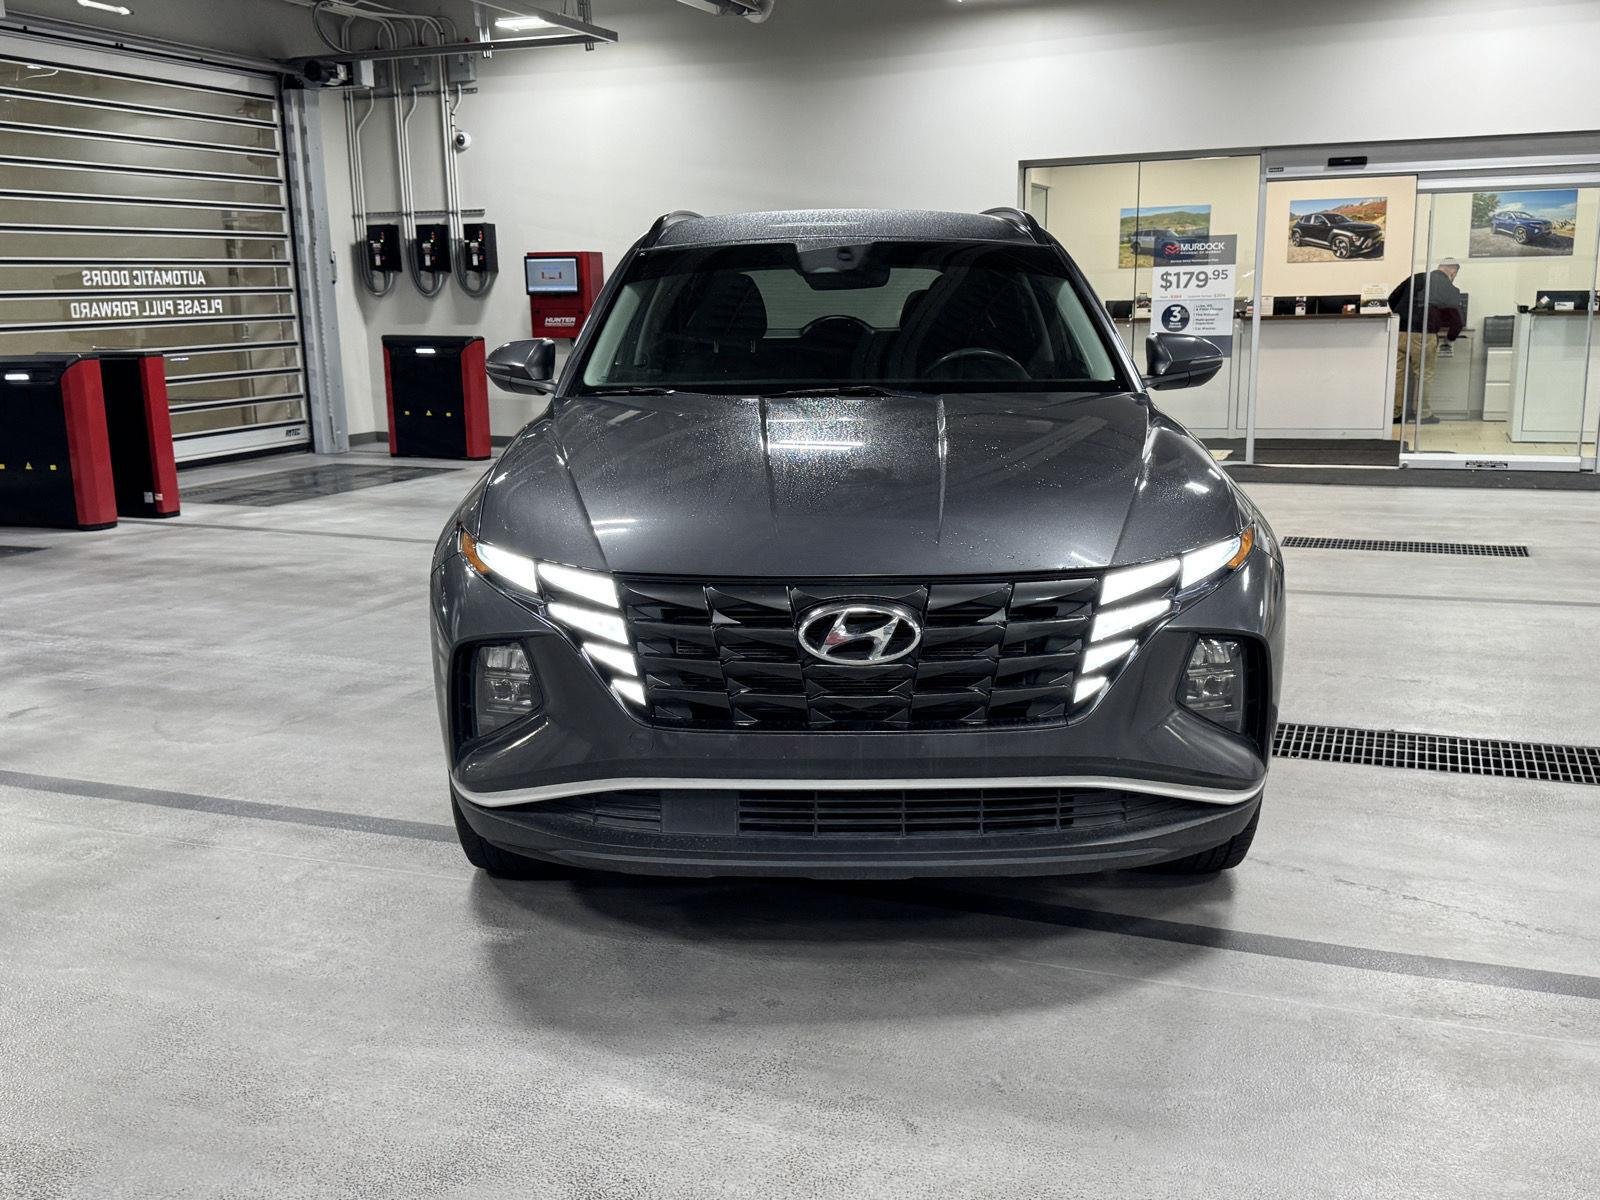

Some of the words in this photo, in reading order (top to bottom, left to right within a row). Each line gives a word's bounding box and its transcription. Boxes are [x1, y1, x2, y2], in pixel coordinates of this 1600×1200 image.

[1180, 242, 1225, 251] MURDOCK
[1160, 269, 1229, 291] $179.95
[545, 316, 576, 324] HUNTER
[1169, 306, 1182, 322] 3
